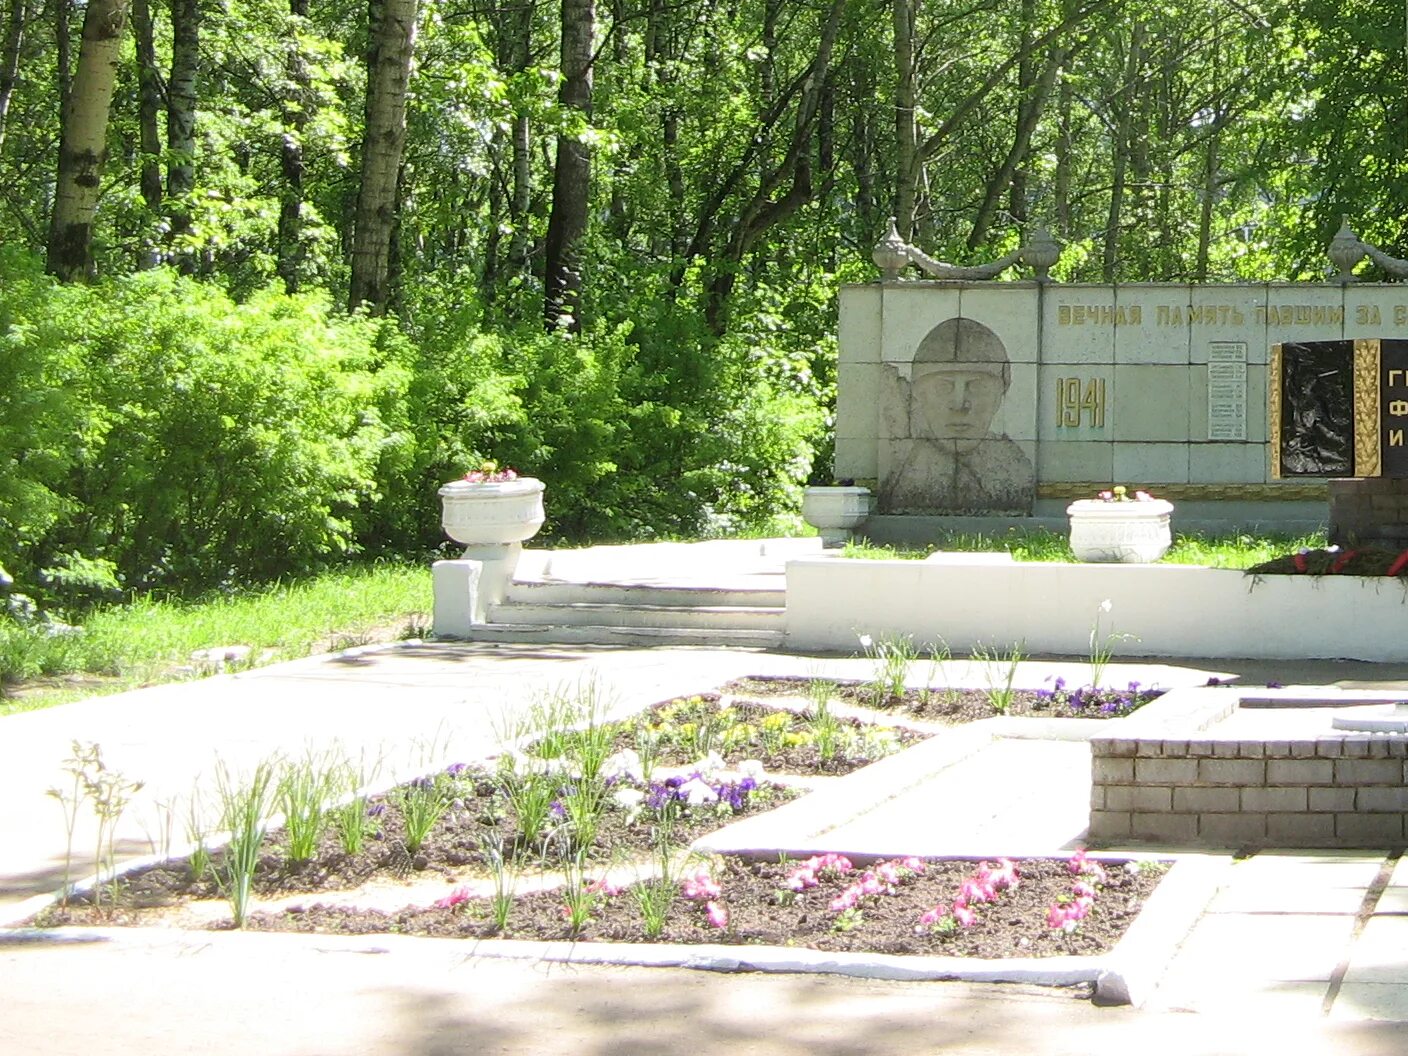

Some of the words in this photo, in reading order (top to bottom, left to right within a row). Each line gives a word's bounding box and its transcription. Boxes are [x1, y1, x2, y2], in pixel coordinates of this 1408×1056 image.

[1057, 304, 1142, 326] ВЕЧНАЯ
[1155, 304, 1245, 326] ПАМЯТЬ
[1255, 304, 1345, 326] ПАВШИМ
[1355, 304, 1382, 326] ЗА
[1056, 377, 1106, 428] 1941
[1388, 429, 1404, 447] И
